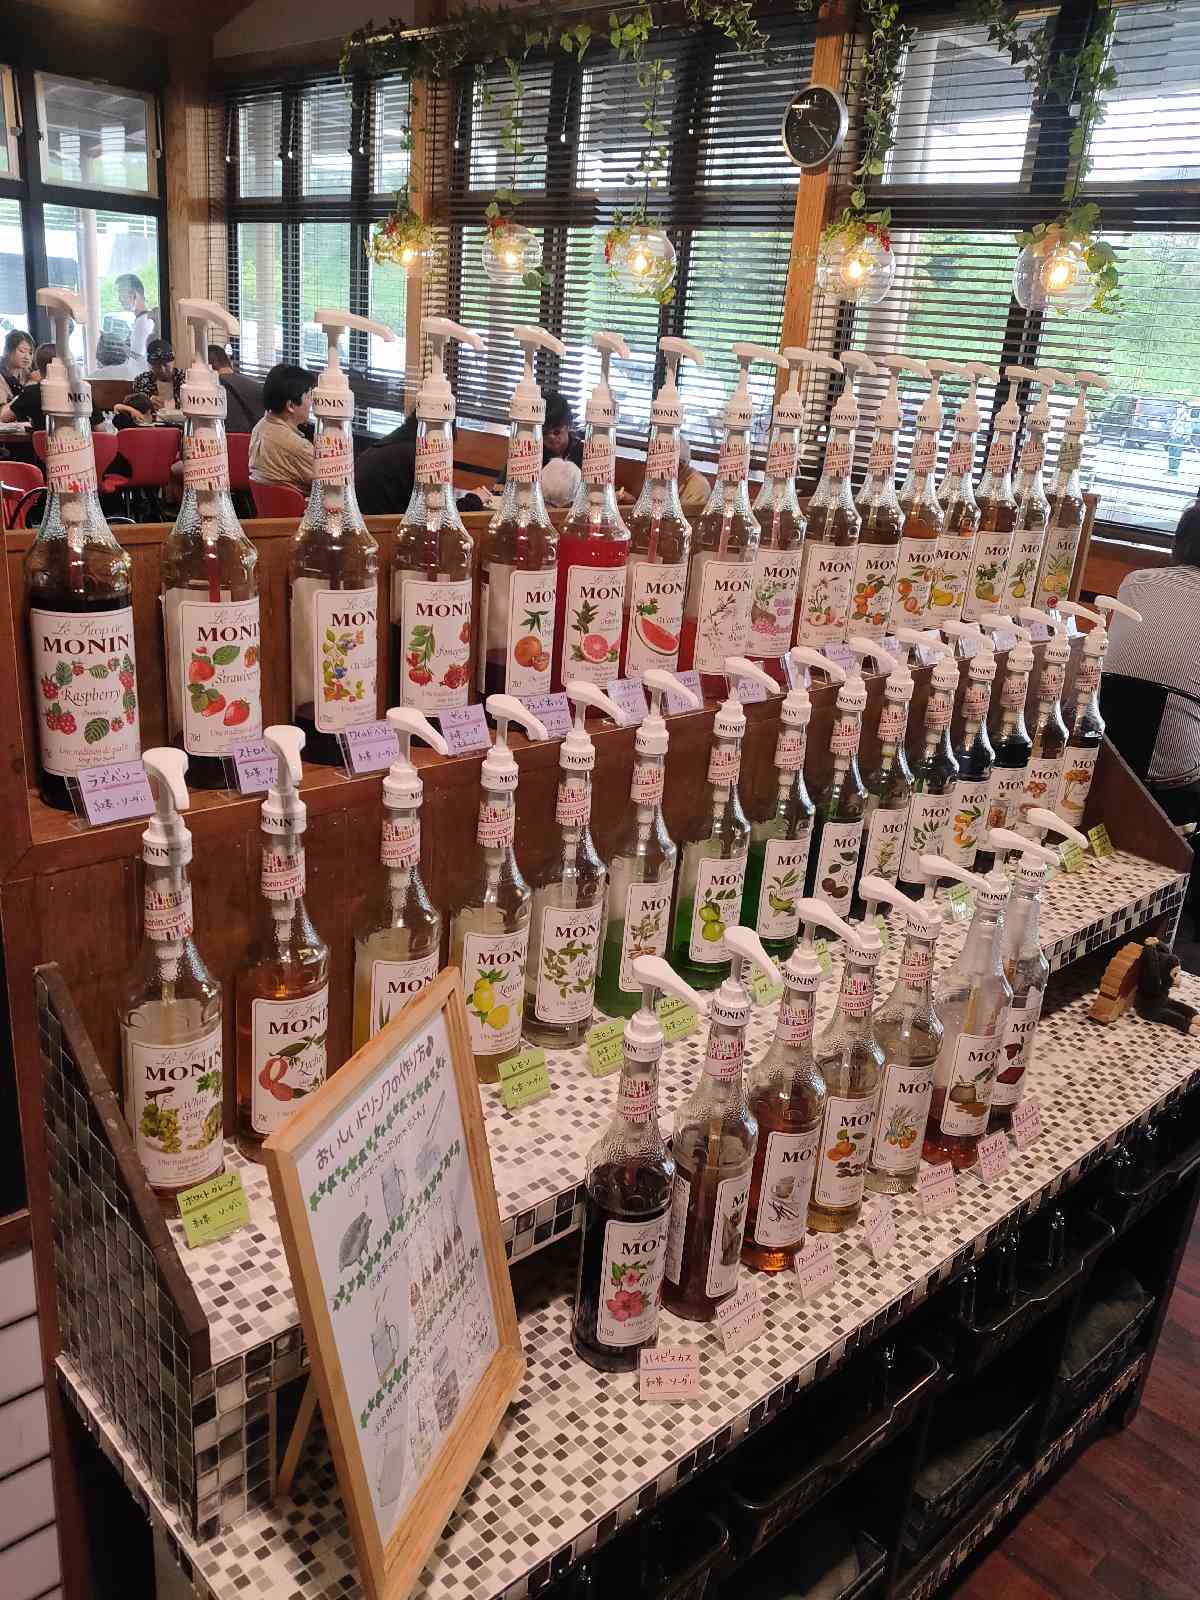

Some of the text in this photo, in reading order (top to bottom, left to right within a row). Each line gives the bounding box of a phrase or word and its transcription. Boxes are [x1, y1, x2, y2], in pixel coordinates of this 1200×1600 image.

[43, 634, 130, 655] MONIN
[62, 687, 120, 707] Raspberry
[145, 1051, 221, 1082] MONIN
